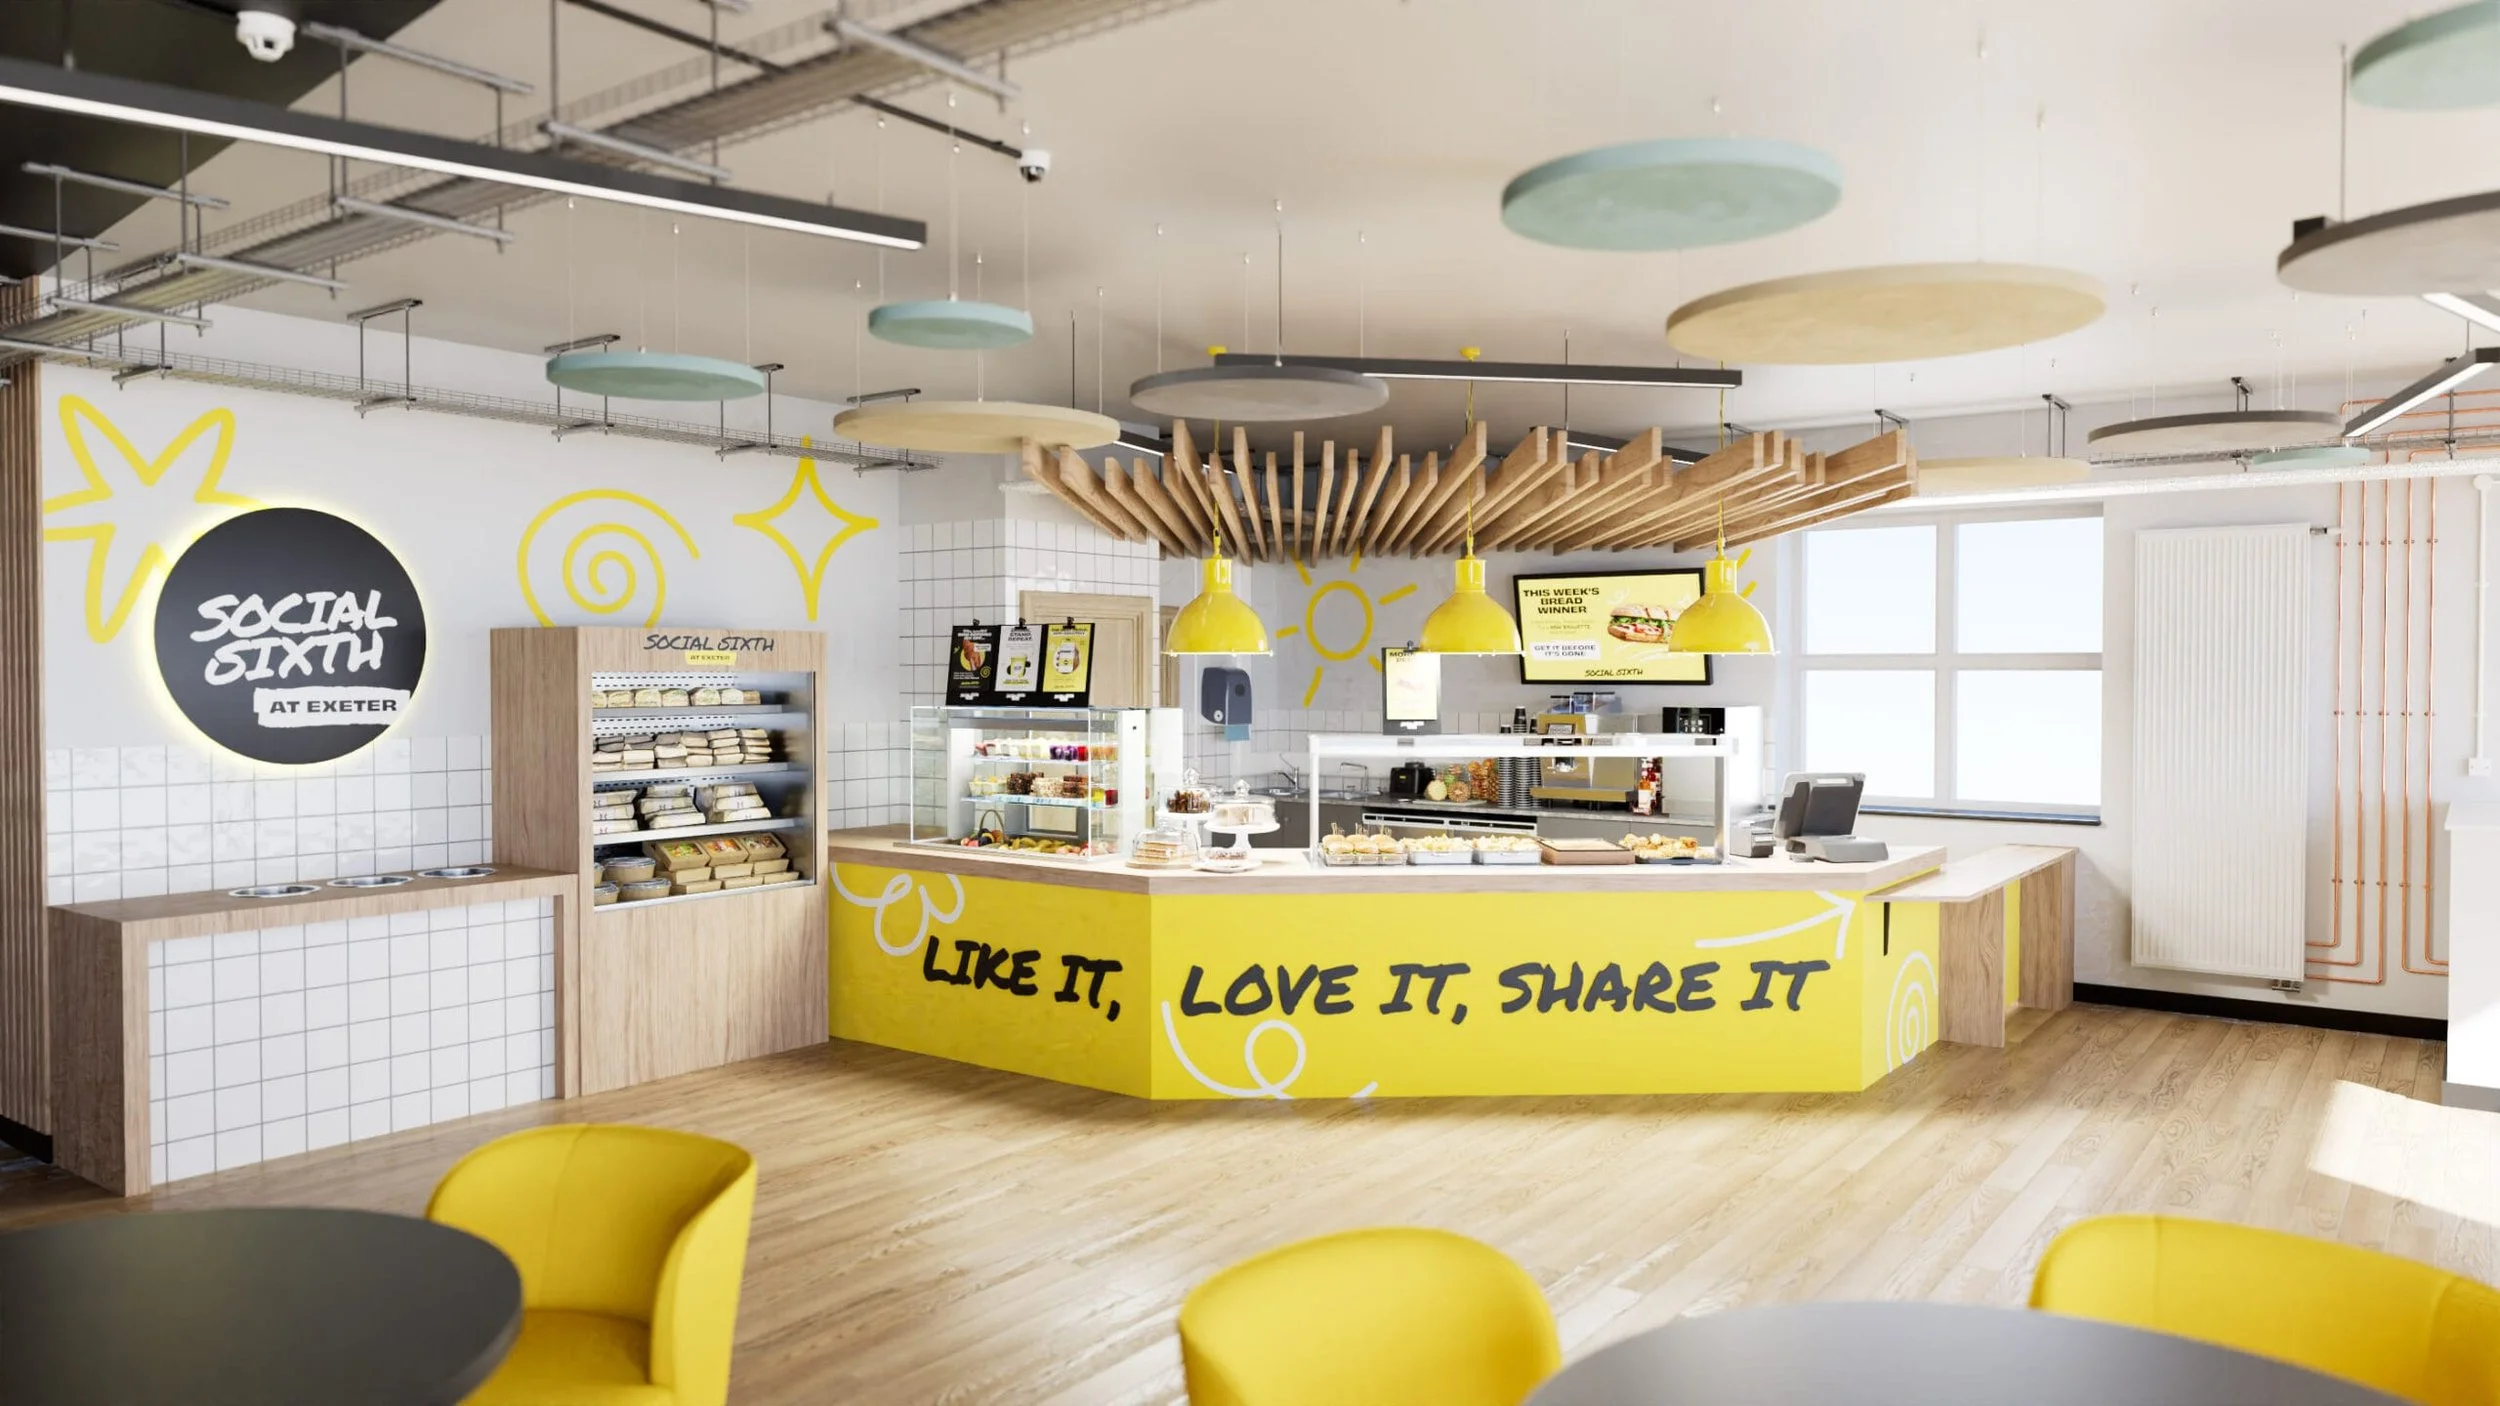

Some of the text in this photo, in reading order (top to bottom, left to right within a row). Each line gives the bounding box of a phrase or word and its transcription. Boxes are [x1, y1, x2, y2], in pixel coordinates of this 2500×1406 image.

[1523, 587, 1600, 597] THIS WEEK'S
[1540, 597, 1583, 605] BREAD
[190, 589, 398, 642] SOCIAL
[1537, 606, 1587, 614] WINNER
[643, 634, 775, 651] SOCIAL SIXTH
[204, 630, 384, 686] SIXTH
[1584, 668, 1643, 677] SOCIAL SIXTH
[269, 699, 398, 714] AT EXETER
[923, 935, 1123, 1022] LIKE IT,
[1180, 960, 1831, 1025] LOVE IT, SHARE IT
